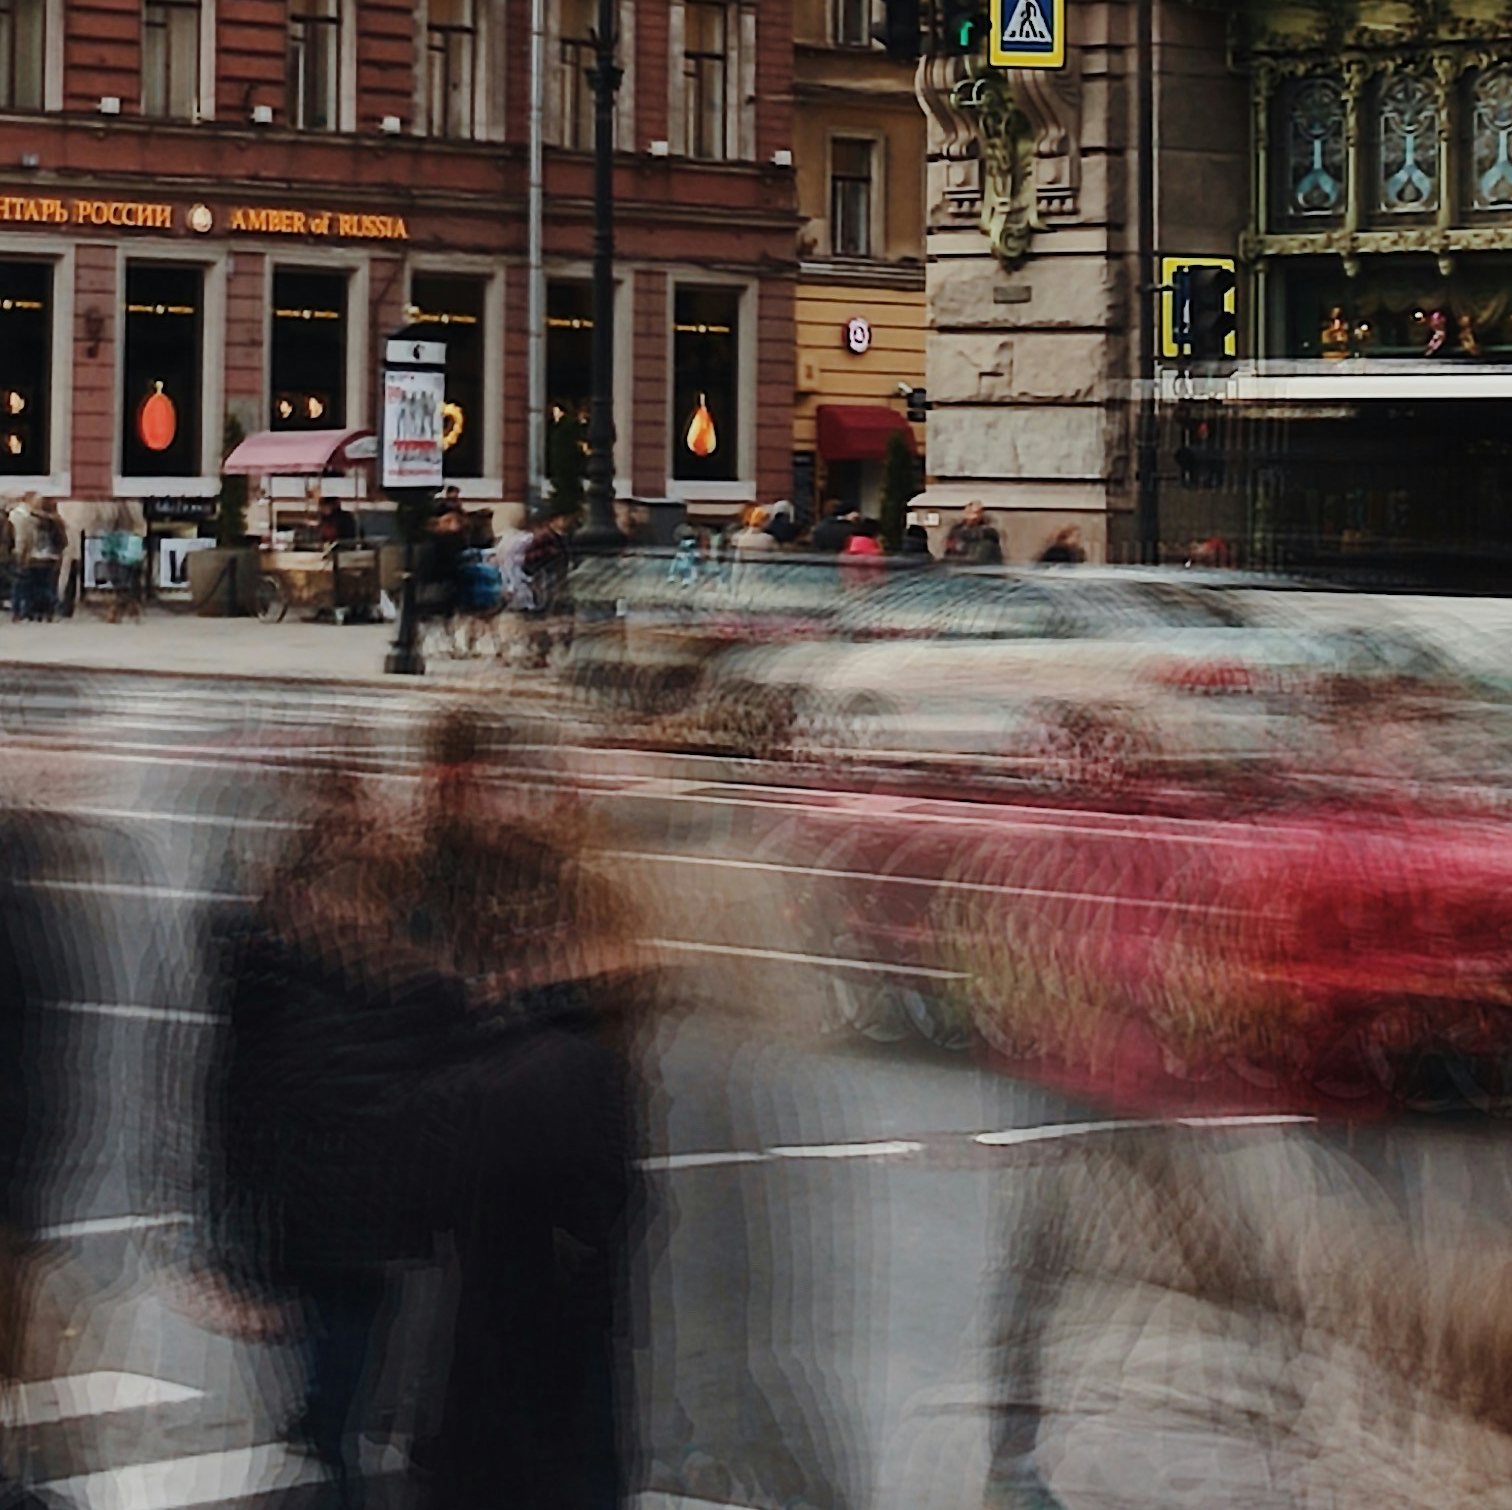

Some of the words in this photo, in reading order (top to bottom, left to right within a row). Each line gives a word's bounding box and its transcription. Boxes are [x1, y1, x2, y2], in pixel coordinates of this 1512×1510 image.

[76, 200, 172, 228] РОССИИ
[231, 208, 306, 234] AMBER
[310, 211, 333, 235] of
[338, 213, 409, 239] RUSSIA
